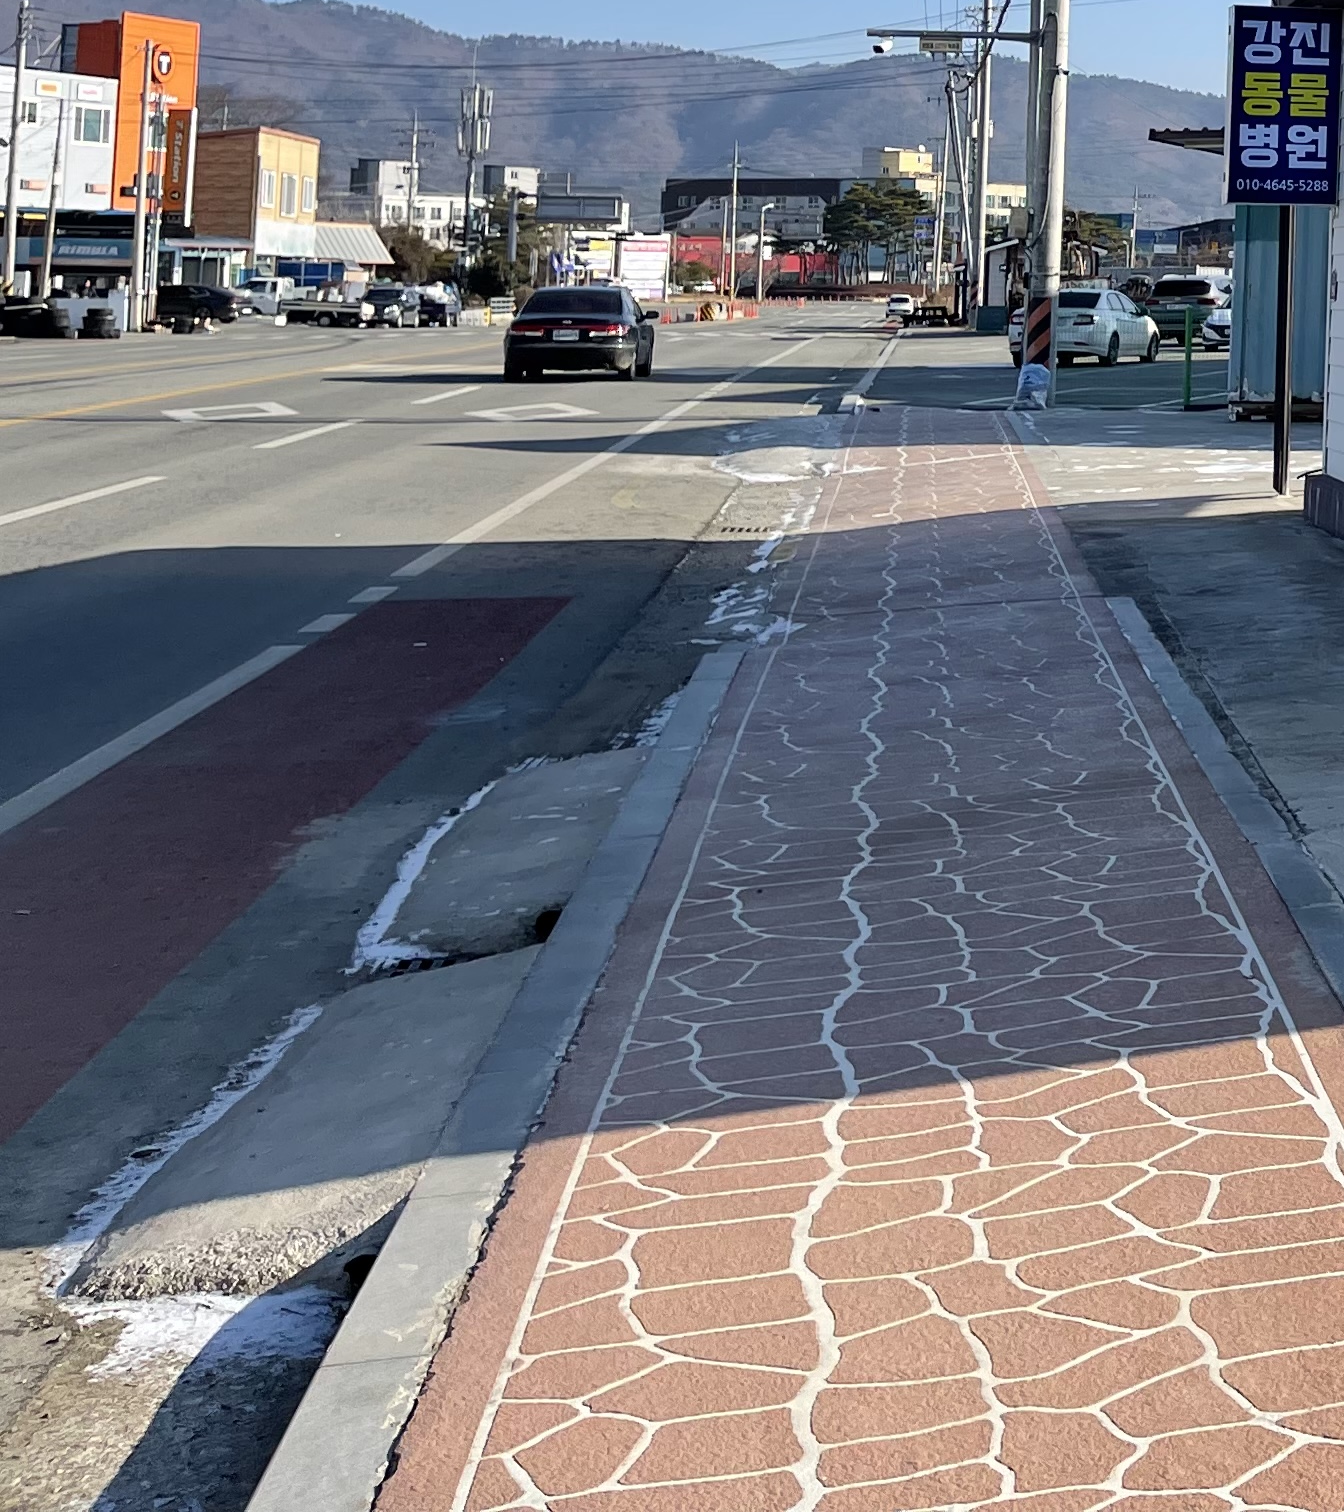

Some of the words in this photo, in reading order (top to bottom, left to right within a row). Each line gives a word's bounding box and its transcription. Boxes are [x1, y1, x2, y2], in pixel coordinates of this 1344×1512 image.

[1242, 20, 1330, 66] 강진
[1241, 71, 1329, 118] 동물
[1239, 124, 1328, 169] 병원
[1236, 178, 1329, 192] 010-4645-5288
[57, 244, 119, 256] RIMULA
